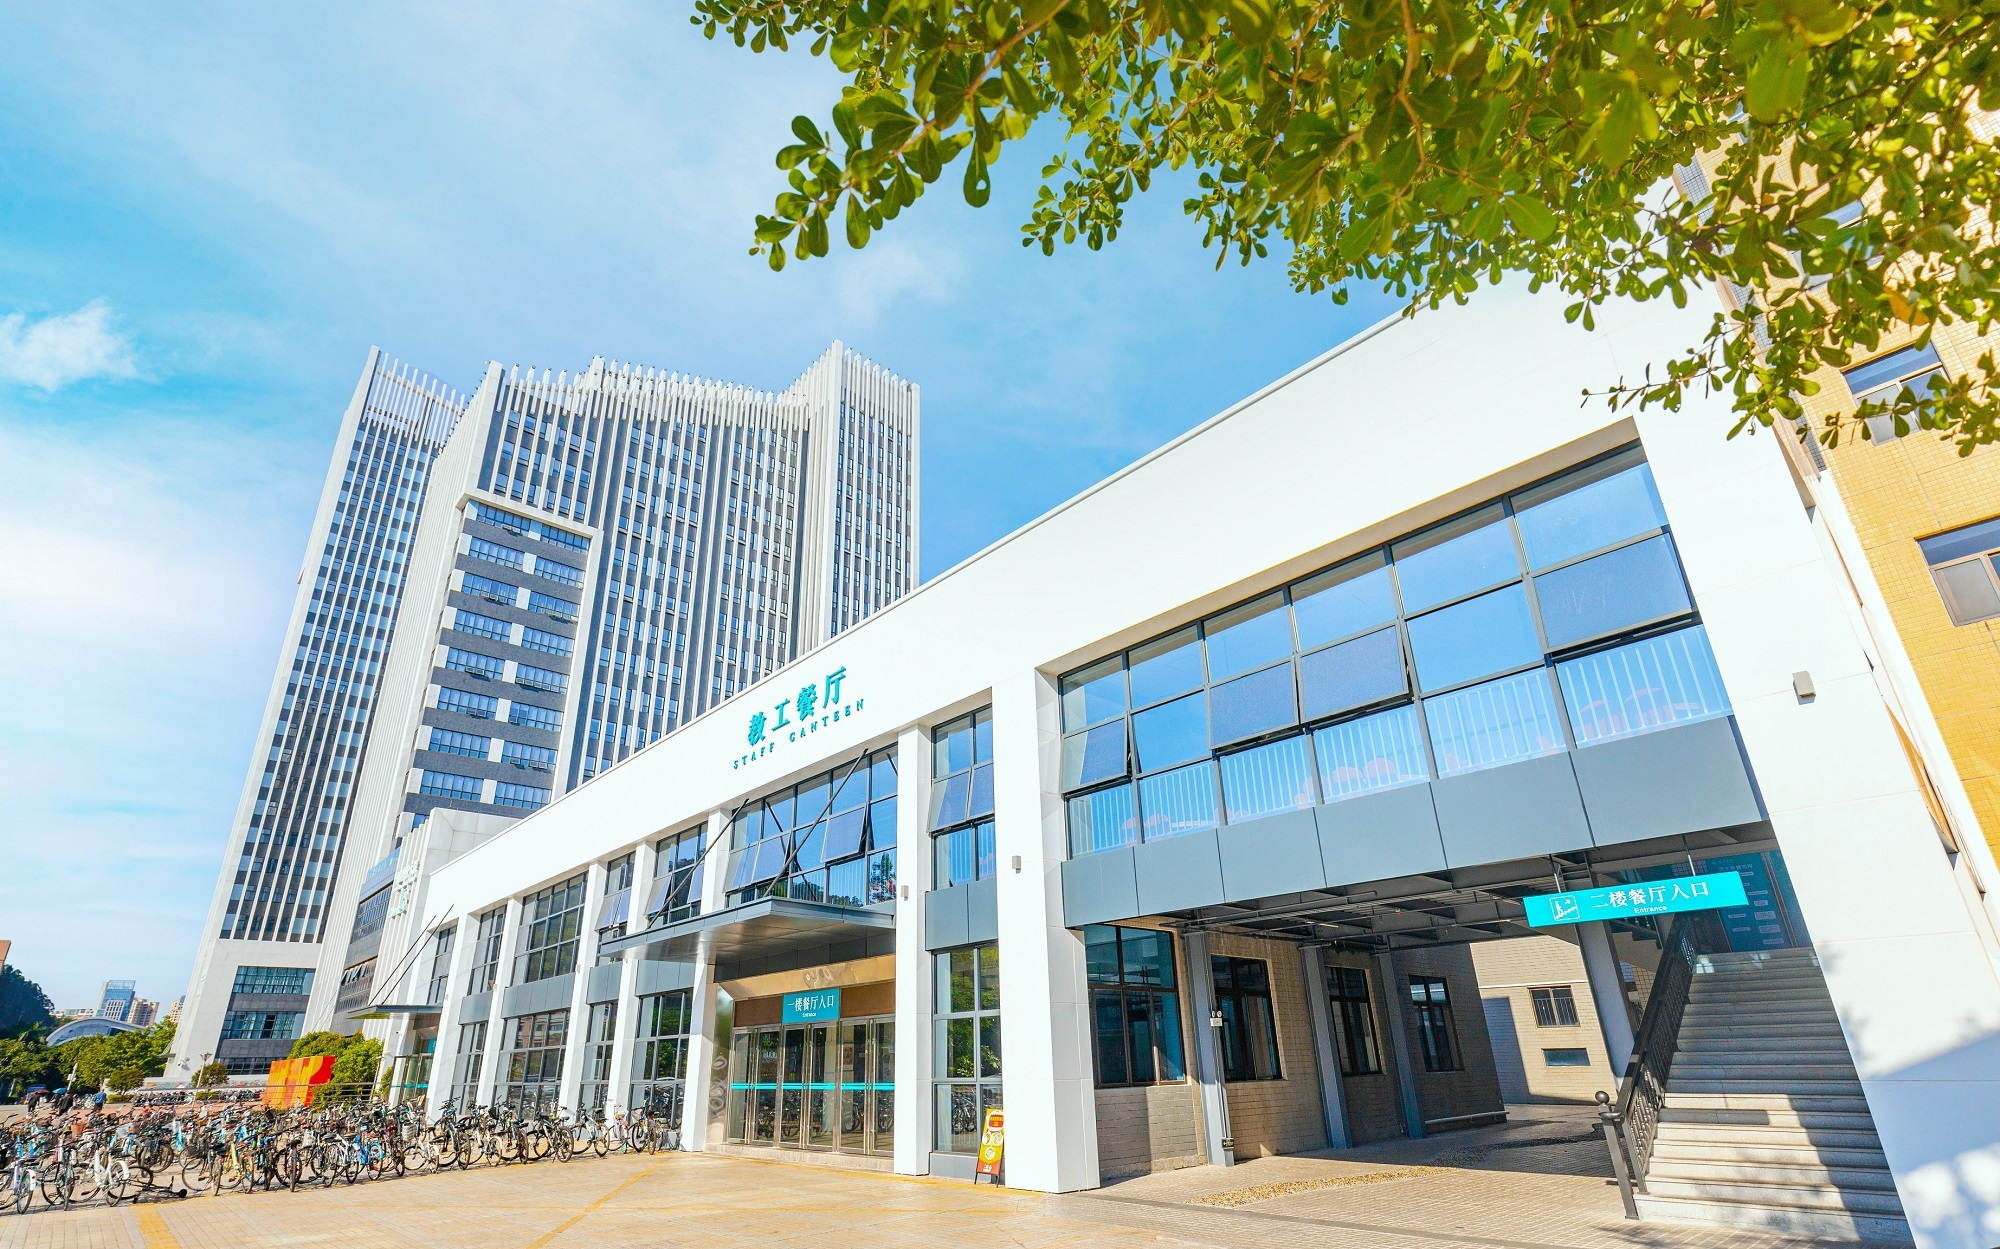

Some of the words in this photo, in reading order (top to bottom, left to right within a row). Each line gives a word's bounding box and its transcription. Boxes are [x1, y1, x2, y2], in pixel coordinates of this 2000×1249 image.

[748, 666, 847, 746] 教工餐厅
[733, 742, 775, 770] STAFF
[789, 699, 865, 743] CANTEEN
[1591, 881, 1709, 908] 二楼餐厅入口
[1634, 905, 1668, 914] Entrance
[788, 995, 834, 1011] 一楼餐厅入口
